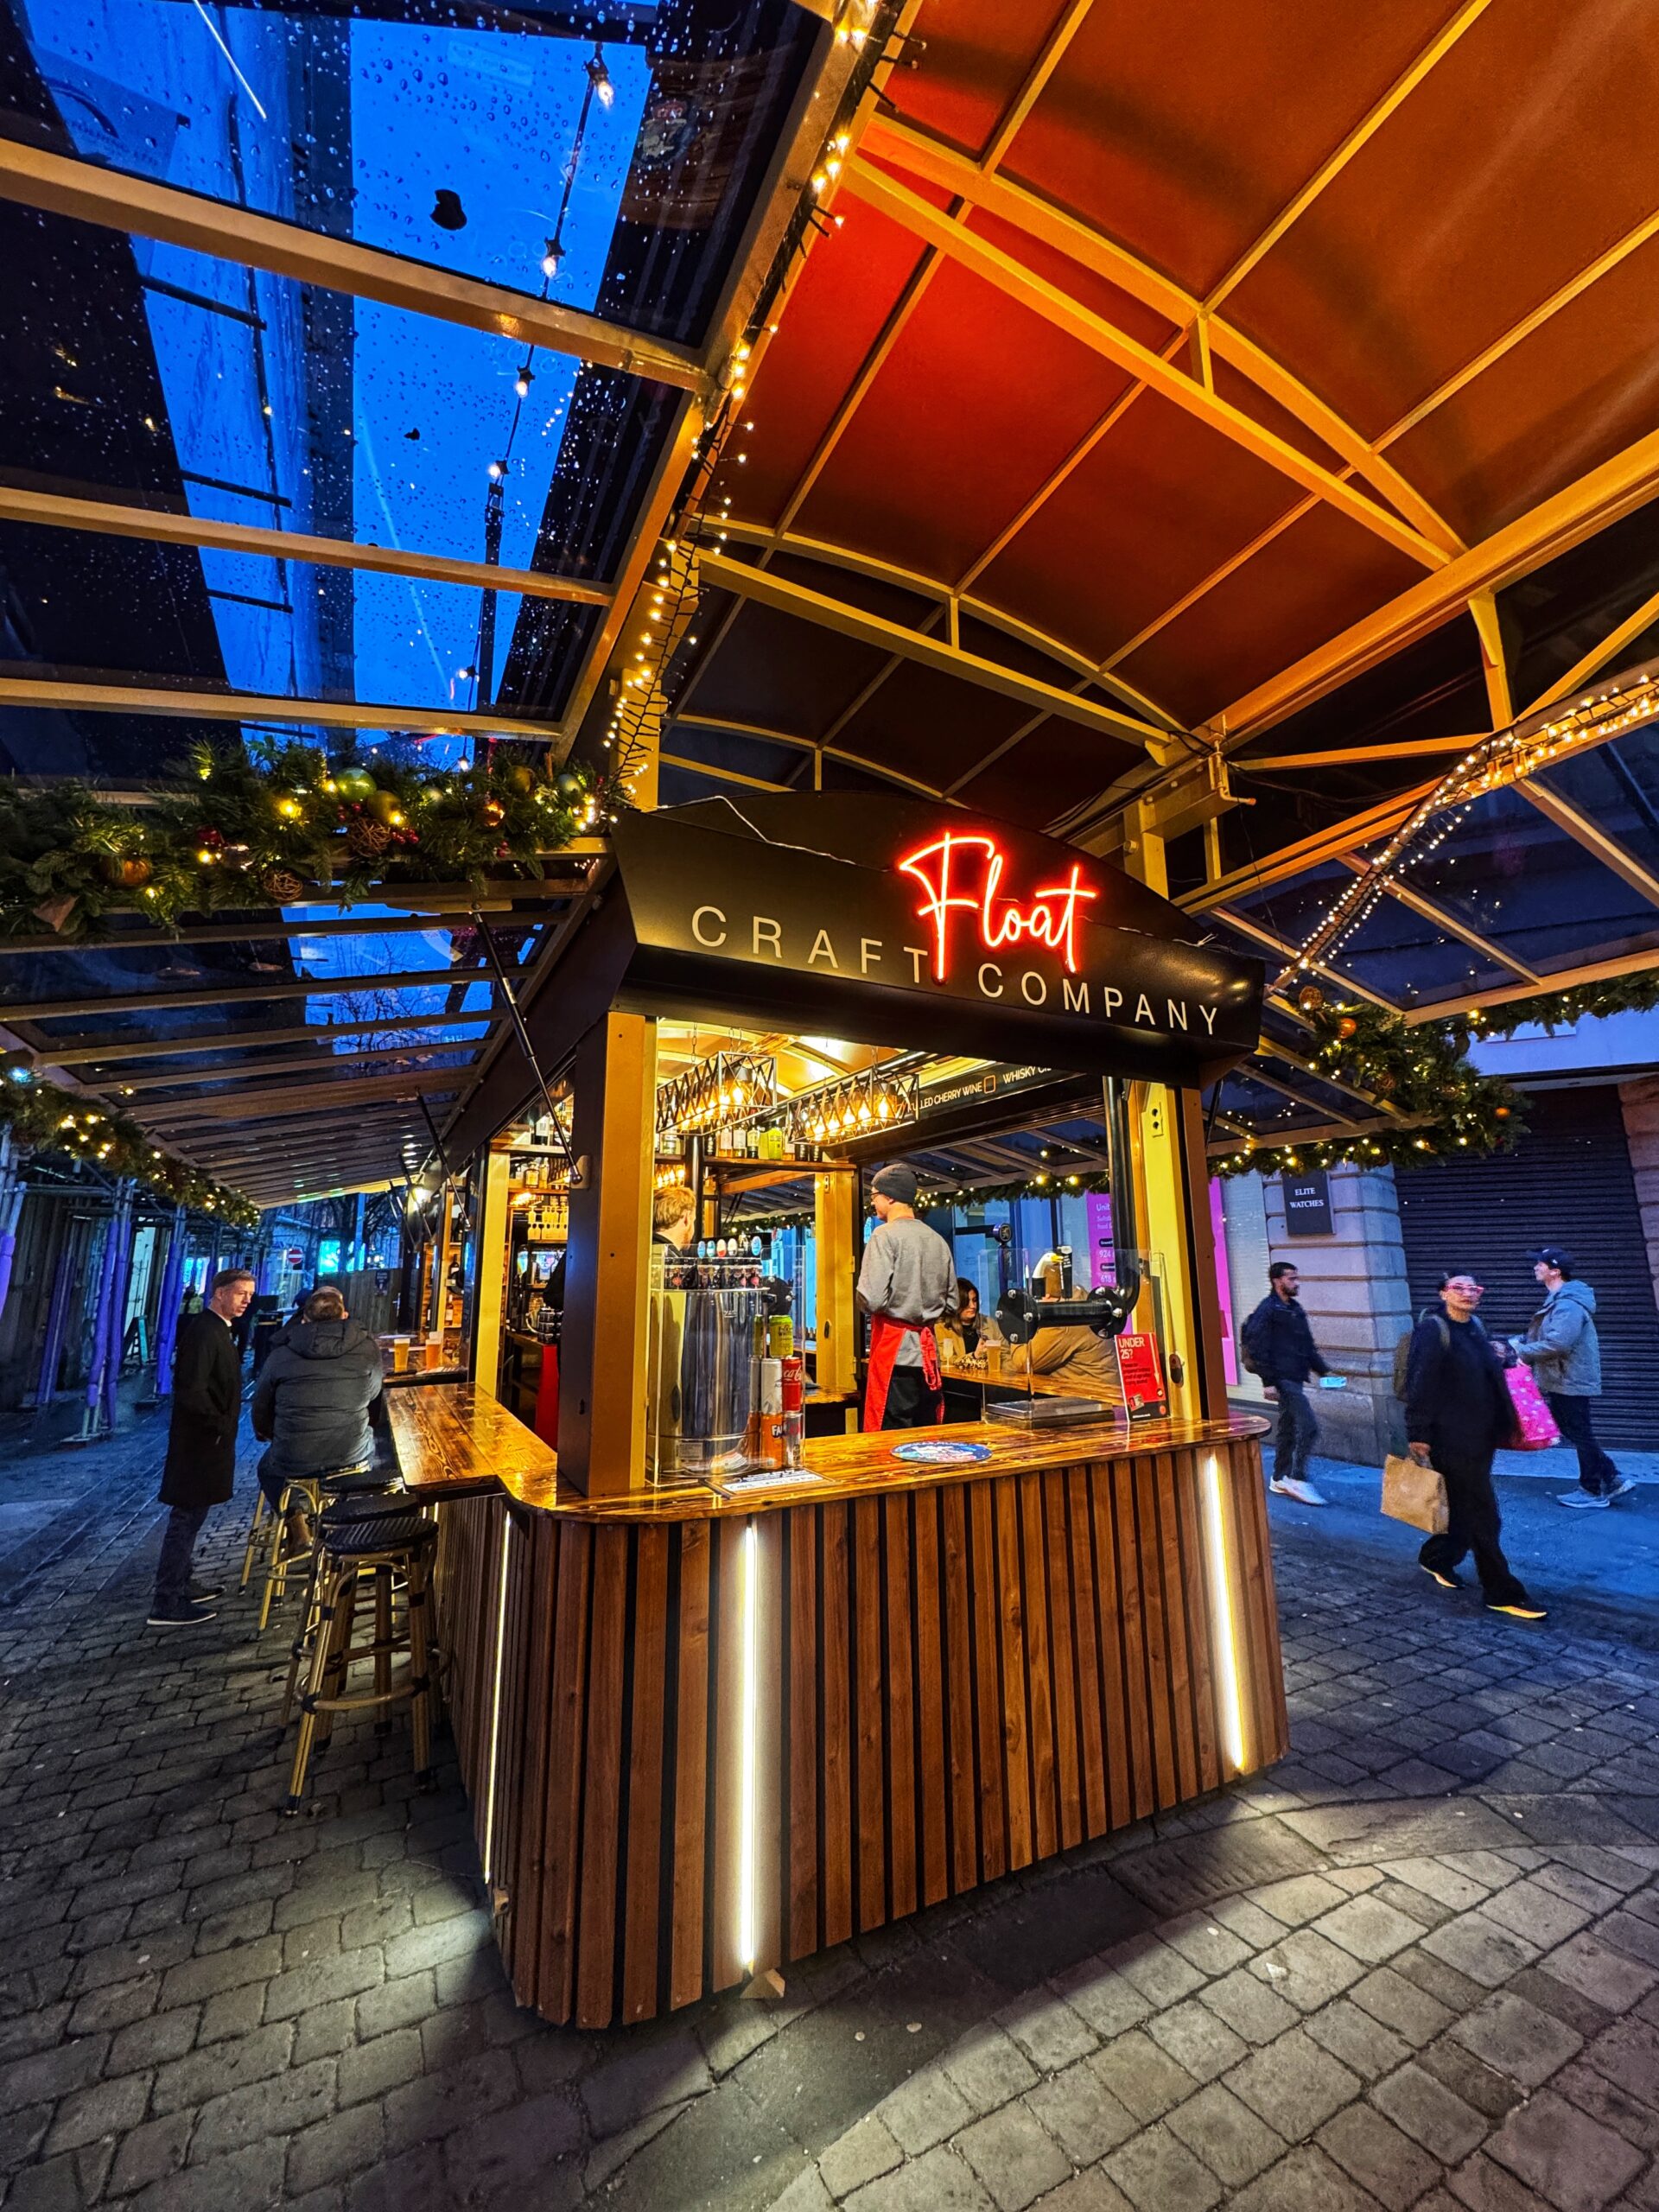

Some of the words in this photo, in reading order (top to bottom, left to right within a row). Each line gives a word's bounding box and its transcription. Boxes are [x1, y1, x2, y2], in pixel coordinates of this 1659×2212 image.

[899, 832, 1096, 981] Float
[691, 906, 929, 984] CRAFT
[977, 963, 1218, 1036] COMPANY
[934, 1087, 962, 1105] CHERRY
[962, 1081, 983, 1096] WINE
[1002, 1065, 1036, 1084] WHISKY
[1294, 1187, 1316, 1196] ELITE
[1289, 1199, 1325, 1209] WATCHES
[1118, 1336, 1146, 1349] UNDER
[1120, 1348, 1134, 1360] 25?
